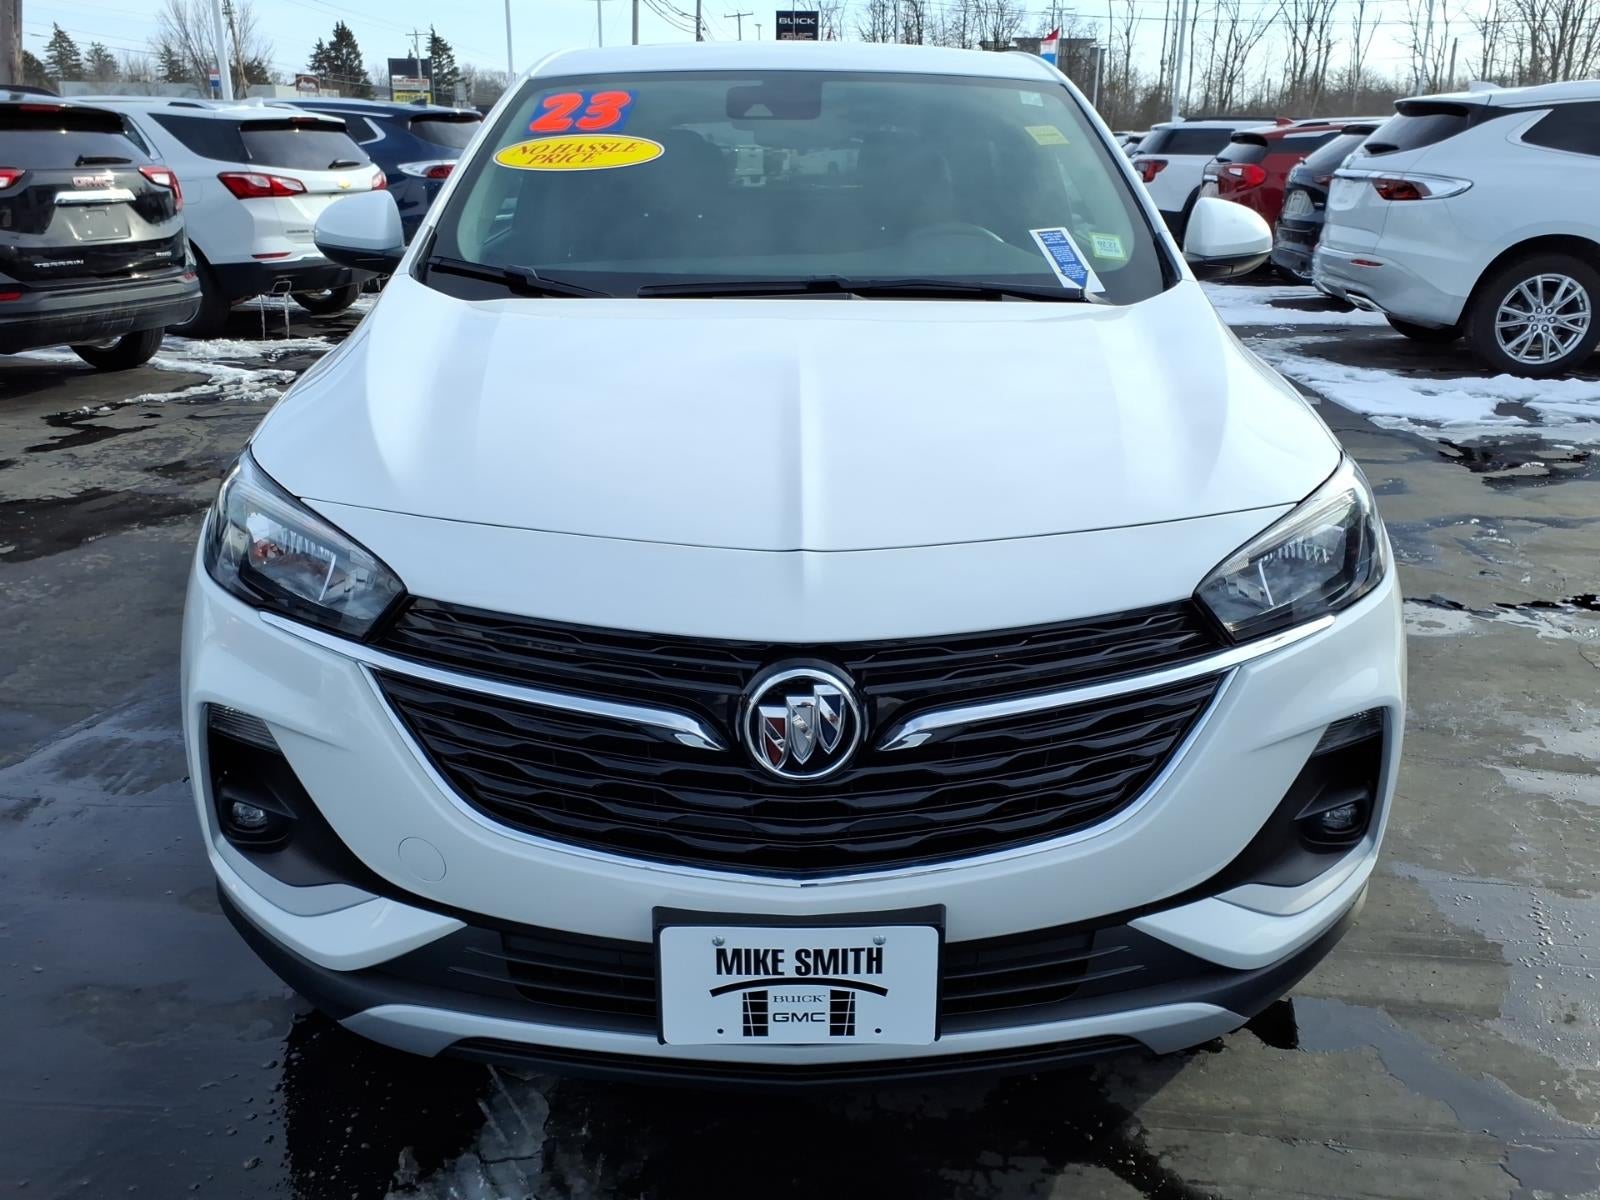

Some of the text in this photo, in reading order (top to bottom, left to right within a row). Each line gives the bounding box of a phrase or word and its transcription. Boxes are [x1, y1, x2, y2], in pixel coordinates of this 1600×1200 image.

[778, 17, 816, 25] BUICK
[781, 32, 814, 40] GMC
[528, 90, 632, 133] 23
[515, 142, 644, 155] NO HASSLE
[527, 152, 600, 165] PRICE
[716, 947, 883, 977] MIKE SMITH
[773, 995, 824, 1003] BUICK
[773, 1012, 826, 1023] GMC
